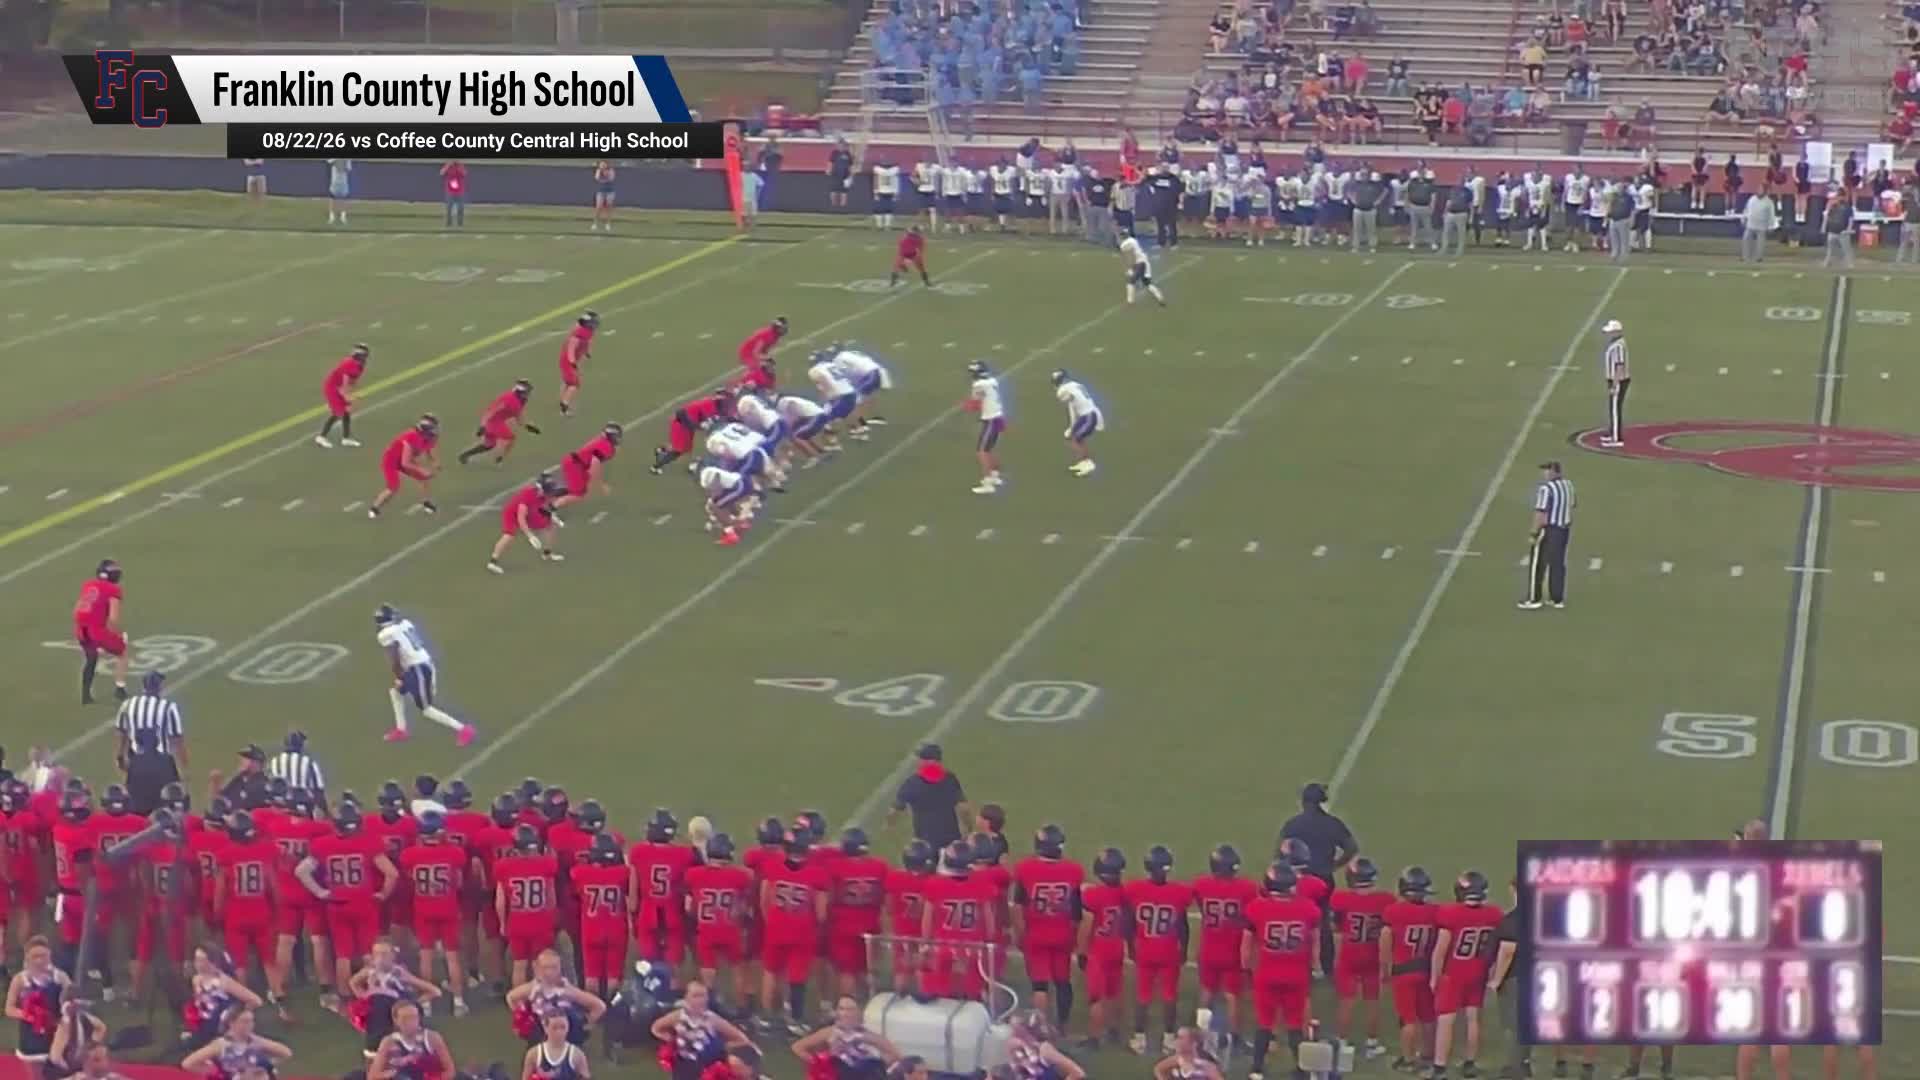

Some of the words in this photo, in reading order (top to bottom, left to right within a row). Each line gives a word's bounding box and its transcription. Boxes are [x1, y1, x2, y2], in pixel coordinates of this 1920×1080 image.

[233, 861, 265, 897] 18
[328, 853, 363, 889] 66
[651, 864, 672, 898] 5
[508, 876, 546, 912] 38
[584, 884, 622, 917] 79
[698, 888, 735, 924] 29
[943, 898, 978, 933] 78
[1135, 901, 1177, 939] 98
[1566, 888, 1592, 941] 0
[1820, 888, 1849, 941] 0
